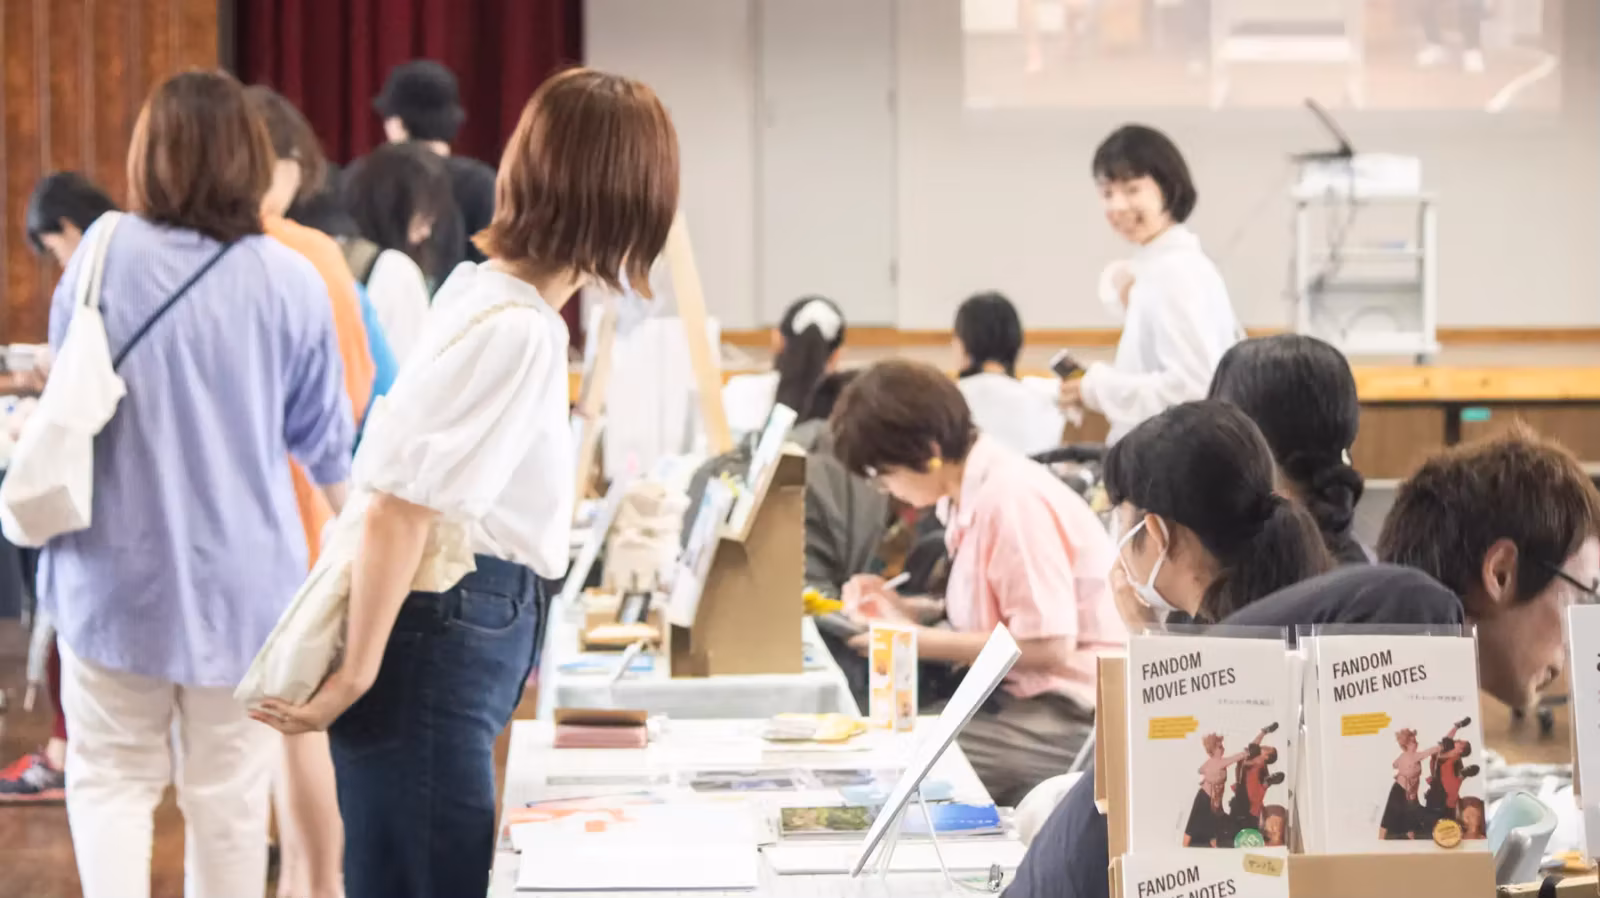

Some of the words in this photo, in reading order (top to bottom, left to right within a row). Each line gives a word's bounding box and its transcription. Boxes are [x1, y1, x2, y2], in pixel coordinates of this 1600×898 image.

[1142, 651, 1202, 680] FANDOM
[1332, 649, 1393, 679] FANDOM
[1142, 679, 1188, 704] MOVIE
[1191, 667, 1236, 692] NOTES
[1333, 676, 1379, 702] MOVIE
[1382, 664, 1427, 690] NOTES
[1137, 865, 1200, 898] FANDOM
